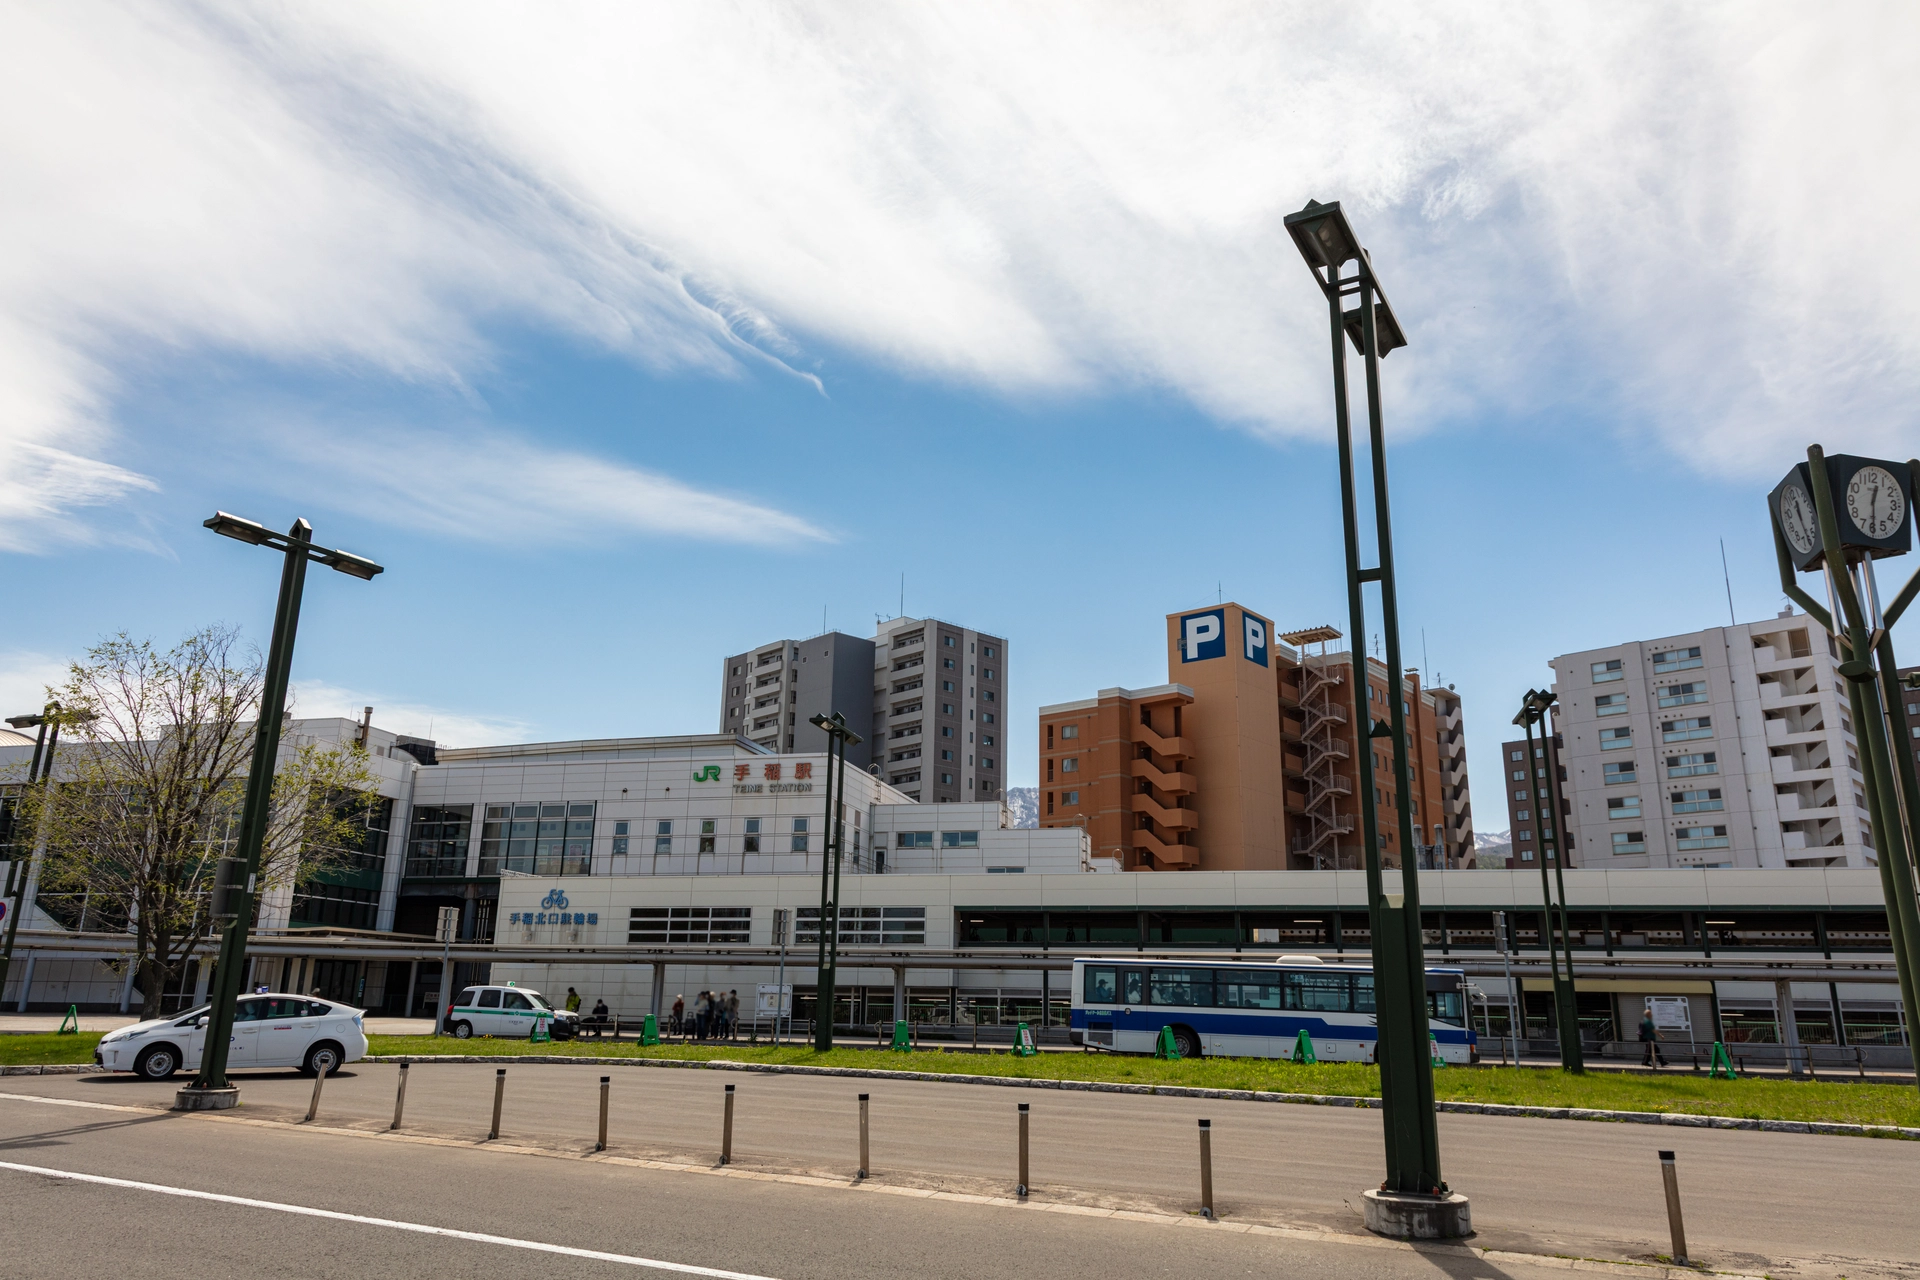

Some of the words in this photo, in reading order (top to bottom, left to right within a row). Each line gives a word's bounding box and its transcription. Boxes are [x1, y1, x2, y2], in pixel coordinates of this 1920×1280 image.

[1859, 473, 1867, 485] 11
[1867, 472, 1878, 484] 12
[1850, 482, 1860, 494] 10
[1887, 486, 1894, 498] 2
[1847, 494, 1855, 506] 9
[1890, 499, 1898, 511] 3
[1851, 506, 1859, 519] 8
[1887, 512, 1894, 523] 4
[1860, 517, 1867, 530] 7
[1868, 522, 1877, 535] 6
[1879, 520, 1887, 532] 5
[1185, 614, 1221, 660] P
[1245, 616, 1265, 659] P
[693, 765, 720, 782] JR
[733, 762, 812, 781] 手稲駅
[733, 784, 763, 794] TEINE
[769, 783, 812, 793] STATION
[509, 912, 598, 925] 手稲北口駐輪場
